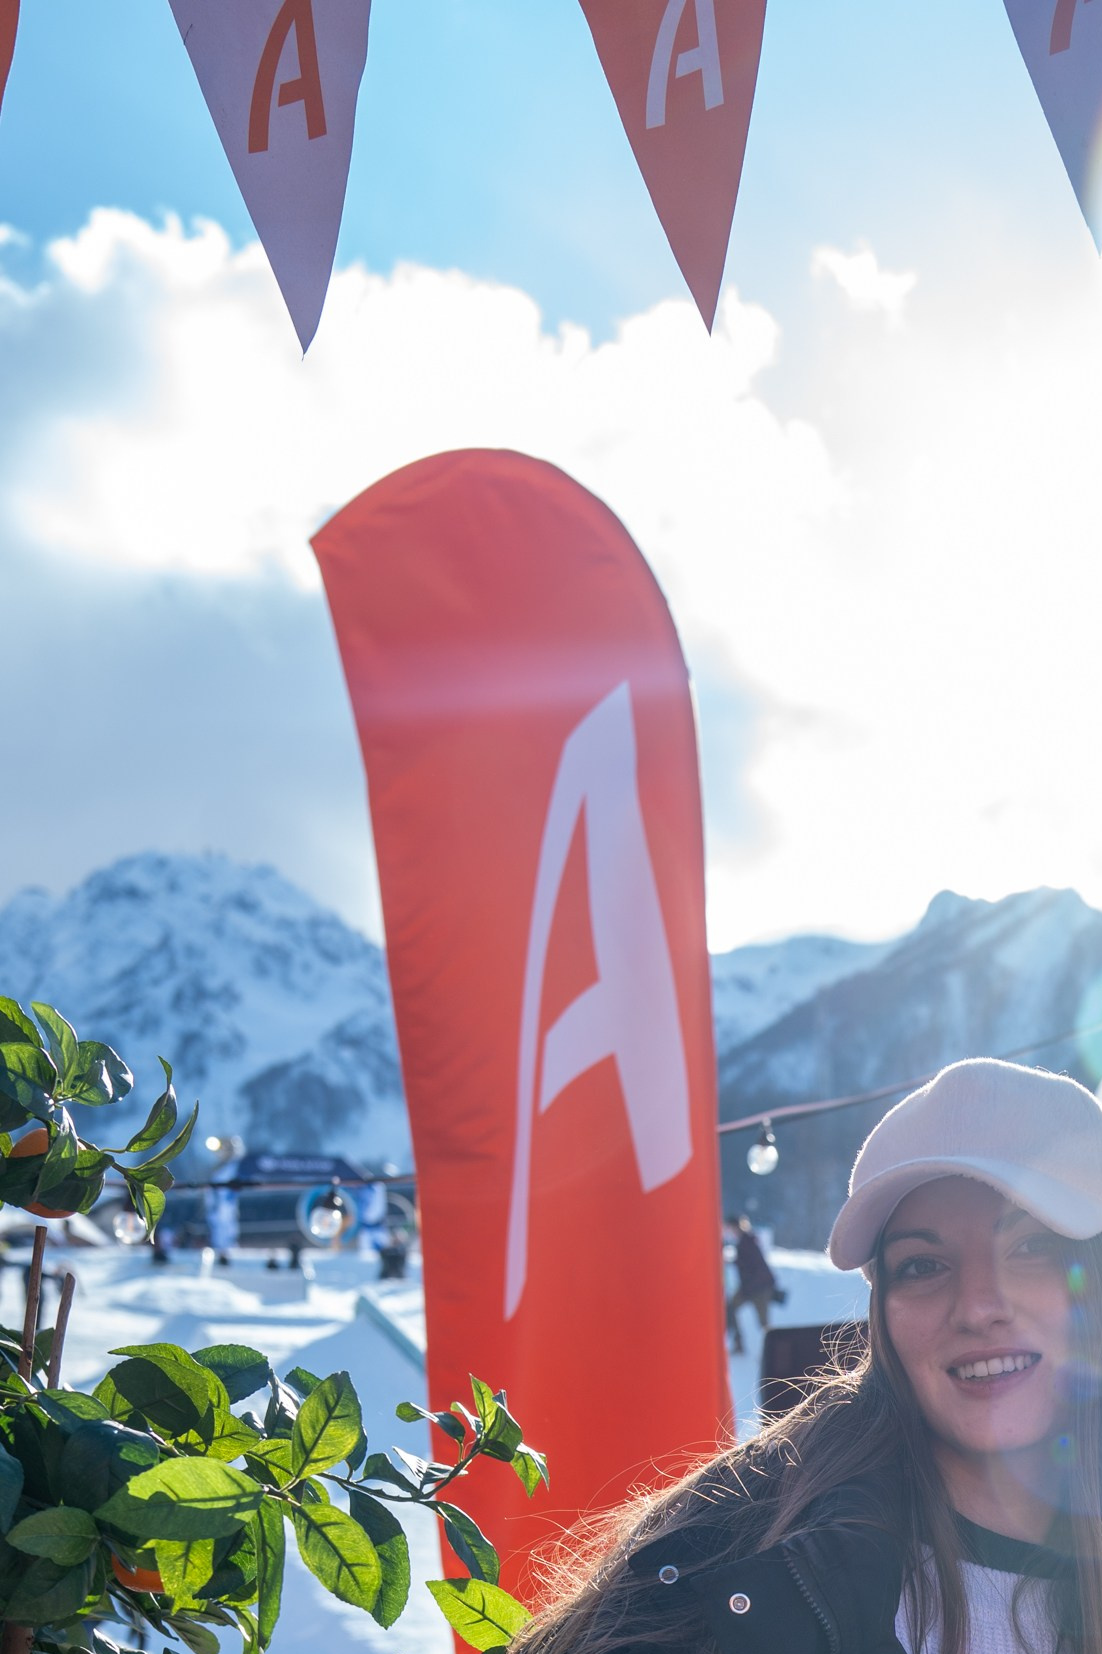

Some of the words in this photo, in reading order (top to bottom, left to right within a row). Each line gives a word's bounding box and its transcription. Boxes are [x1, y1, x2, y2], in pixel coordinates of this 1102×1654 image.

[247, 0, 327, 153] A
[646, 0, 725, 129] A
[503, 681, 692, 1321] A
